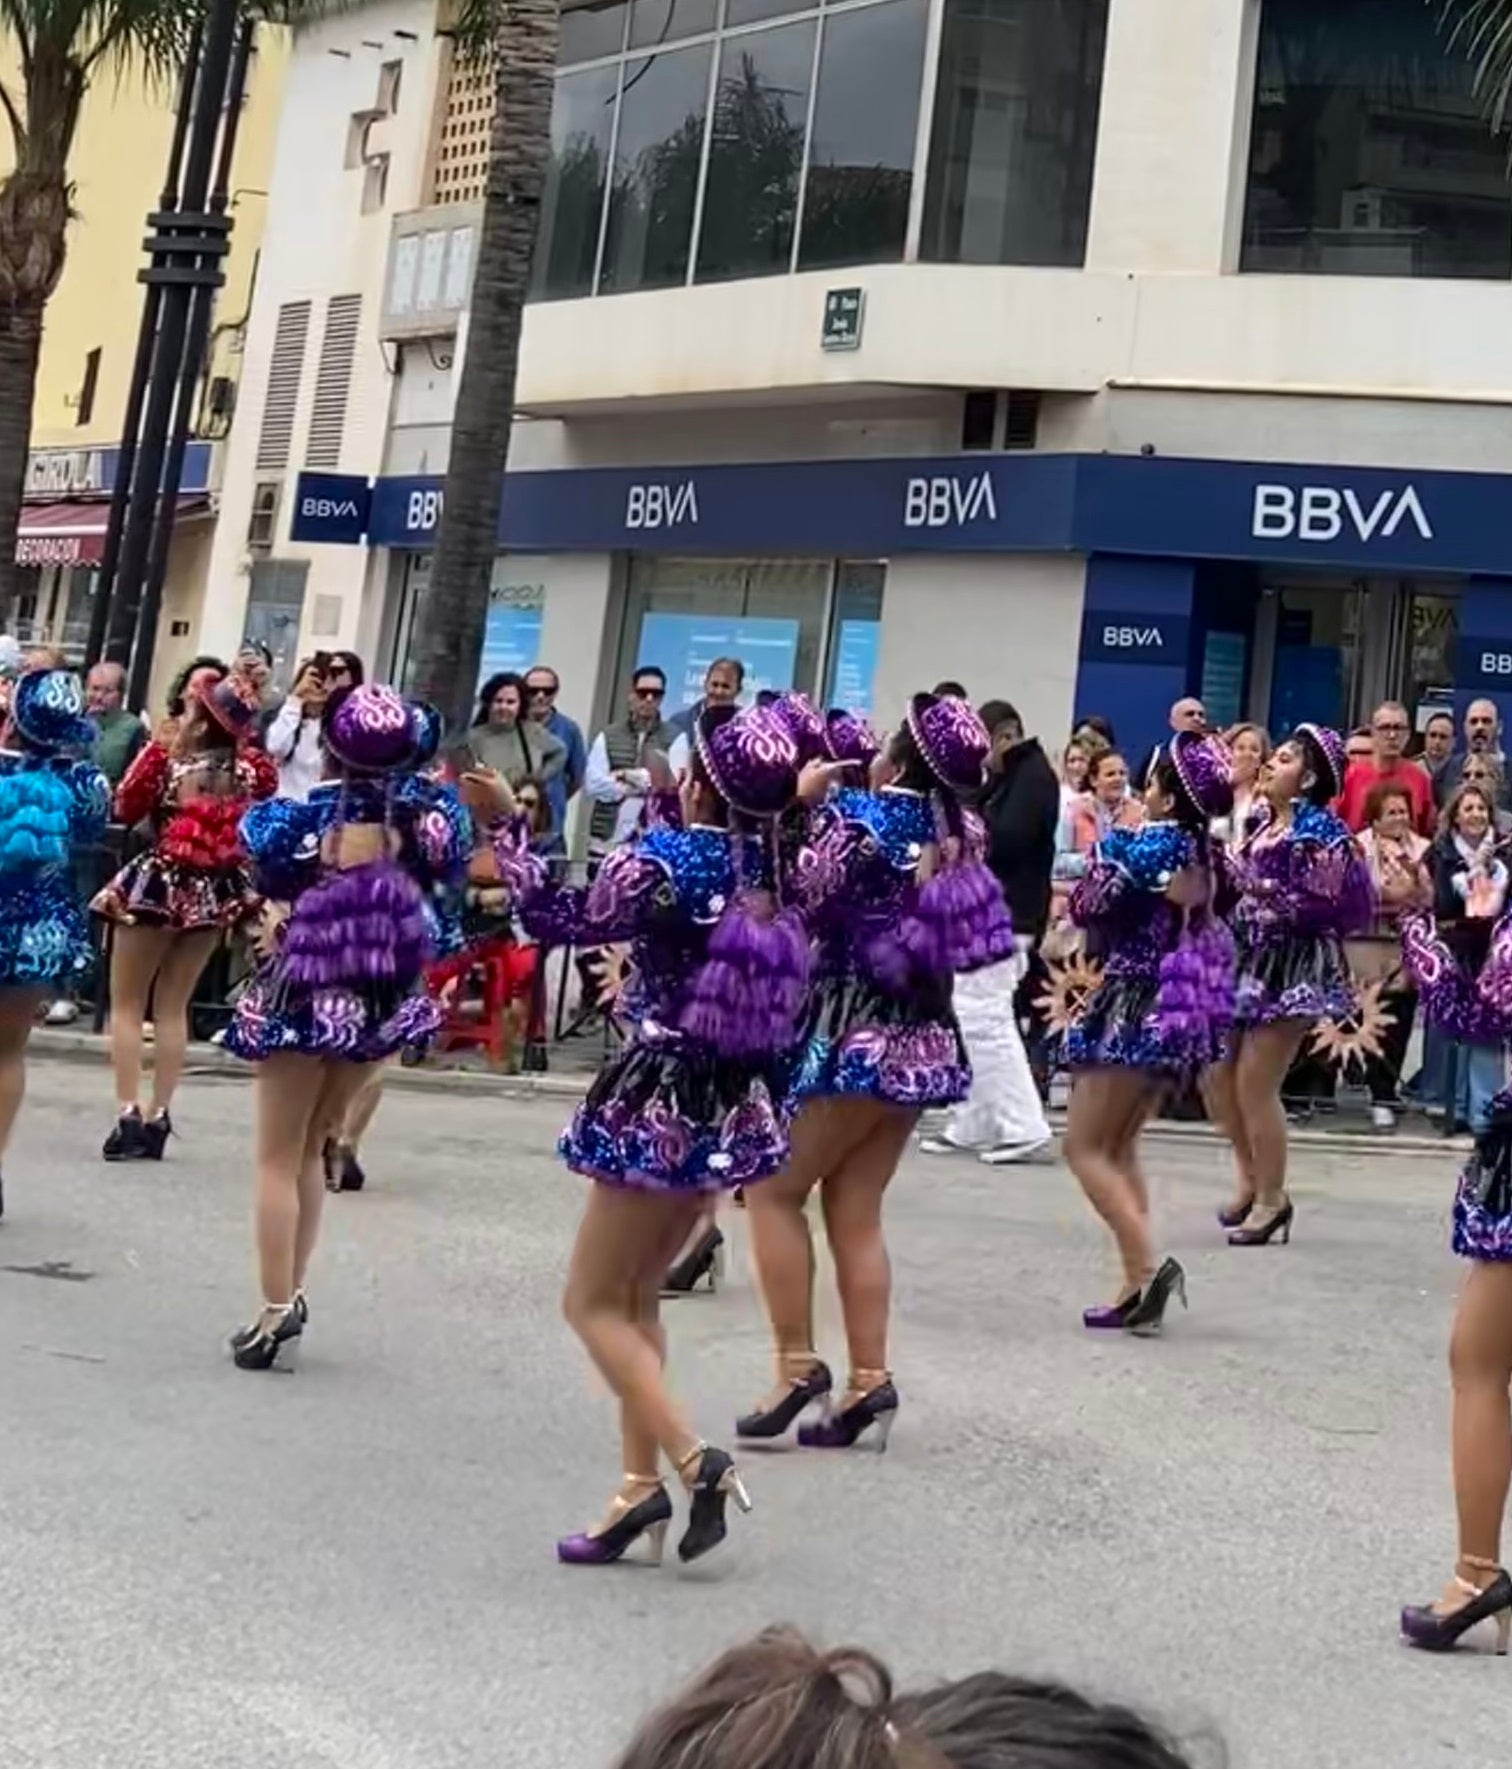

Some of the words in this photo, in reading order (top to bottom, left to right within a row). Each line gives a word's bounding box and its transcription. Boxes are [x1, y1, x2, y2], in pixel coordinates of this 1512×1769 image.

[302, 498, 358, 517] BBVA
[406, 491, 444, 529] BB
[626, 481, 698, 528] BBVA
[905, 471, 996, 526] BBVA
[1252, 484, 1433, 542] BBVA
[1103, 626, 1163, 647] BBVA
